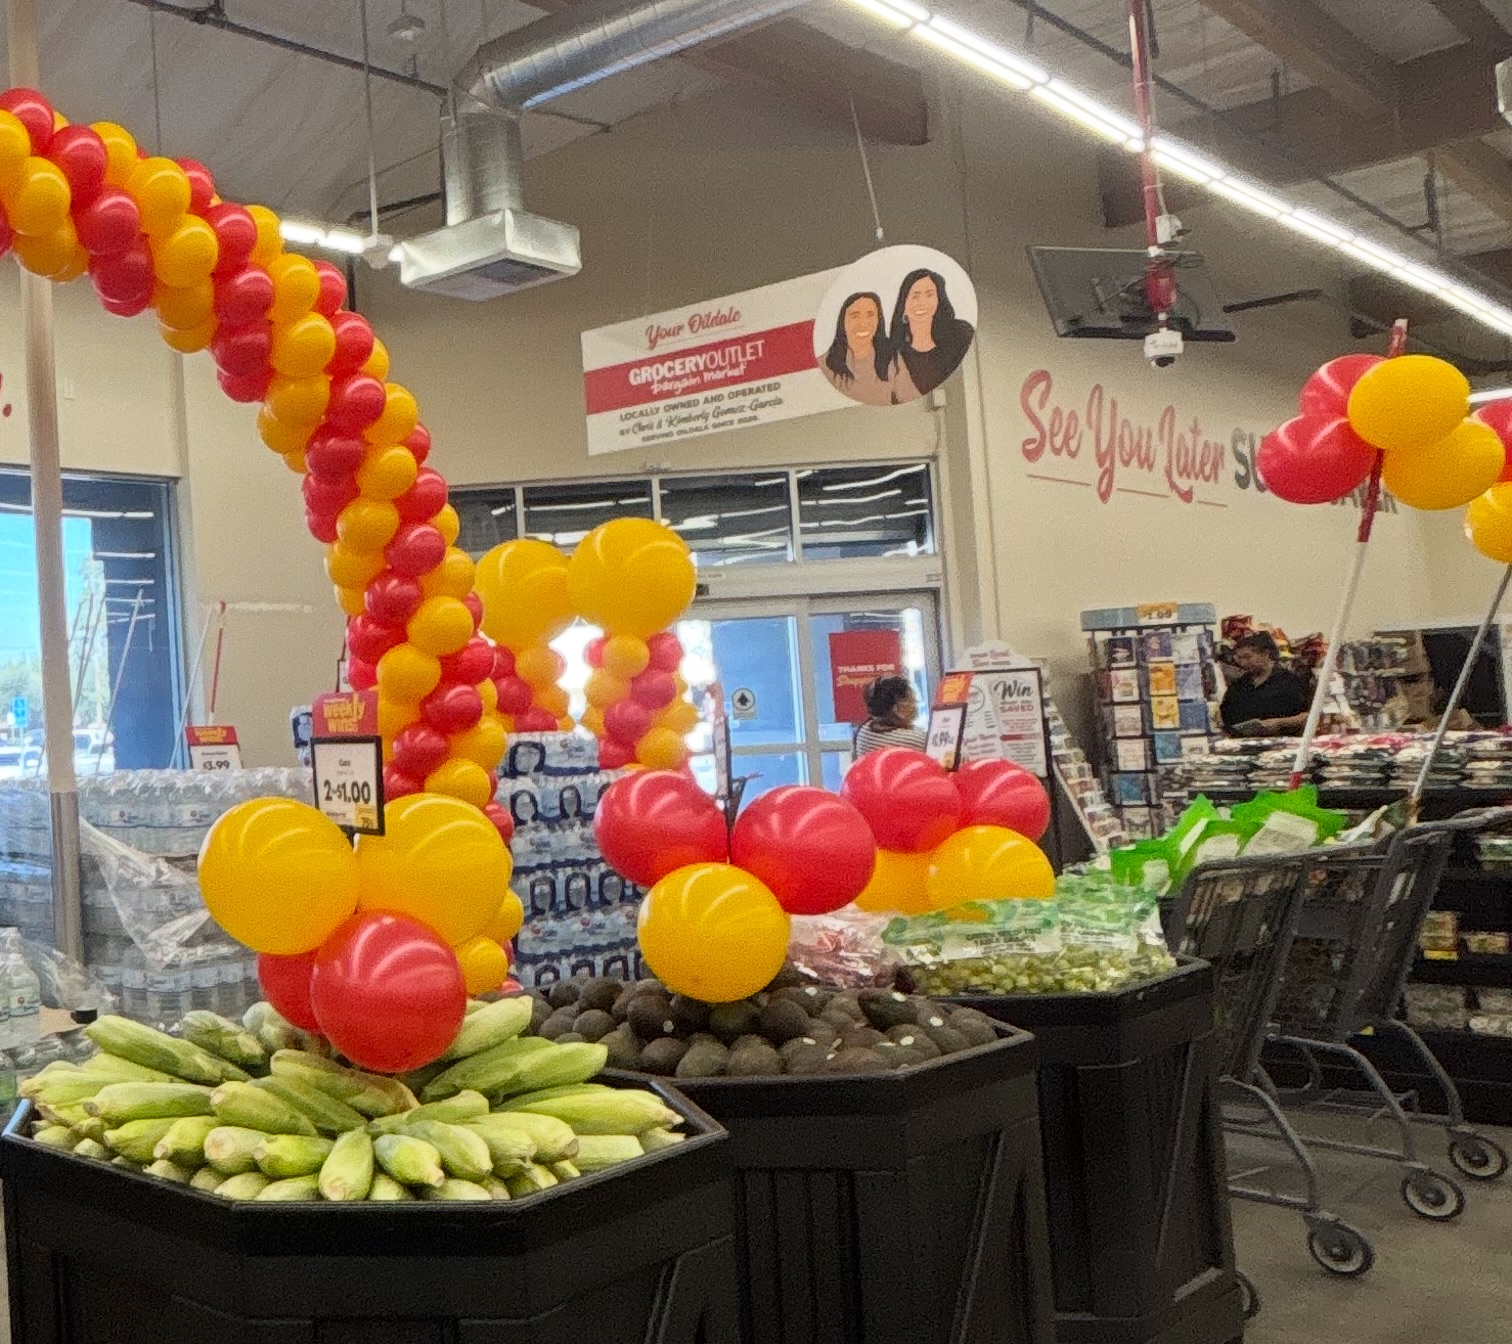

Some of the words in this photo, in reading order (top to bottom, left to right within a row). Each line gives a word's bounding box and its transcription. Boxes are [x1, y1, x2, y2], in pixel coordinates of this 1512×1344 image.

[645, 323, 684, 351] Your
[688, 306, 742, 334] Oildale
[651, 377, 701, 396] bargain
[703, 362, 748, 383] market
[619, 405, 661, 422] LOCALLY
[703, 393, 725, 405] AND
[727, 382, 782, 400] OPERATED
[1020, 369, 1085, 463] See
[1086, 383, 1157, 504] You
[1157, 405, 1226, 504] Later
[993, 679, 1033, 701] Win
